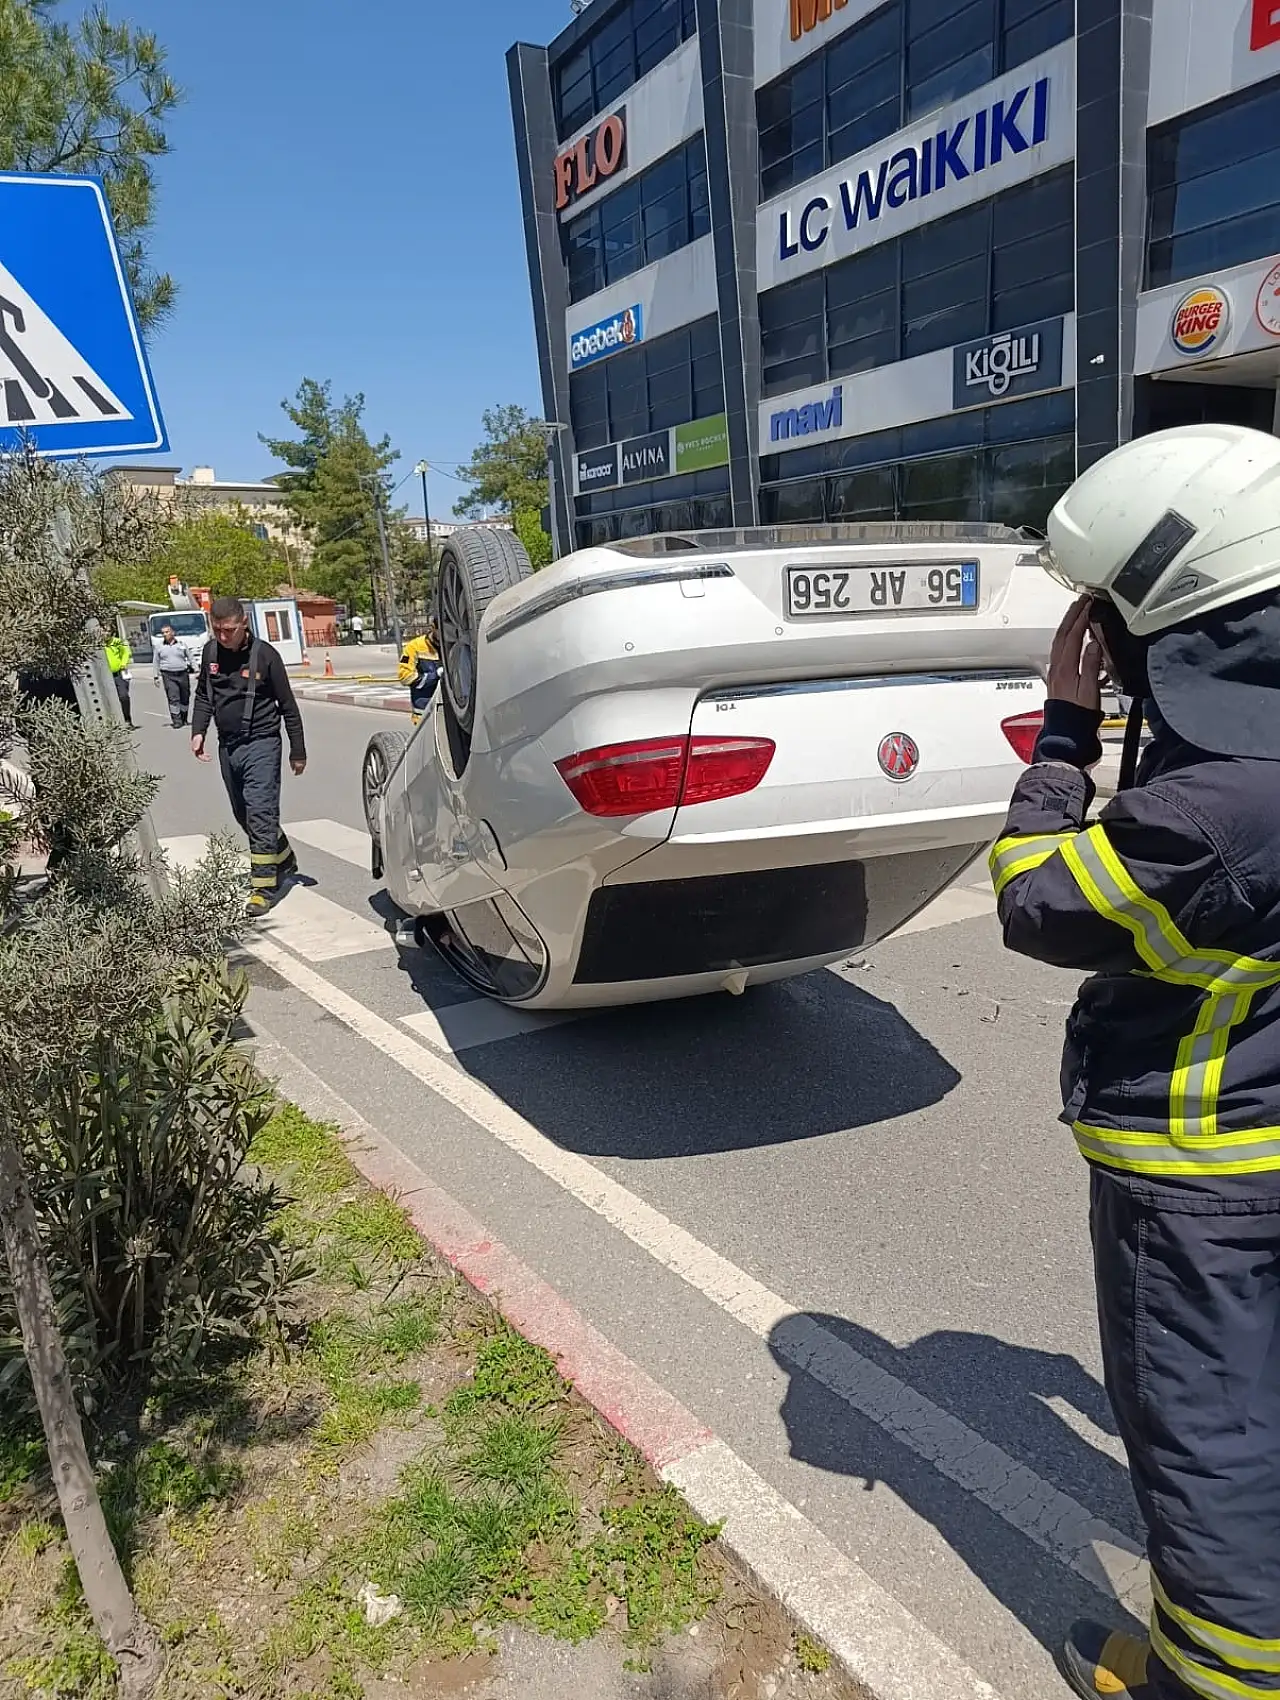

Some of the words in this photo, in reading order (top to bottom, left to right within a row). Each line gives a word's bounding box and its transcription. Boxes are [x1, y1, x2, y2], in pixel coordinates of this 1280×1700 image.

[554, 115, 624, 209] FLO
[779, 197, 831, 260] LC
[1175, 313, 1221, 338] KING
[1177, 302, 1223, 322] BURGER
[572, 319, 623, 361] ebebek
[771, 385, 842, 442] mavi
[623, 446, 664, 470] ALVINA
[792, 572, 850, 610] 256
[870, 570, 906, 606] AR
[927, 568, 962, 604] 56
[962, 572, 975, 583] TR
[995, 681, 1033, 690] PASSAT
[716, 703, 737, 712] TDI
